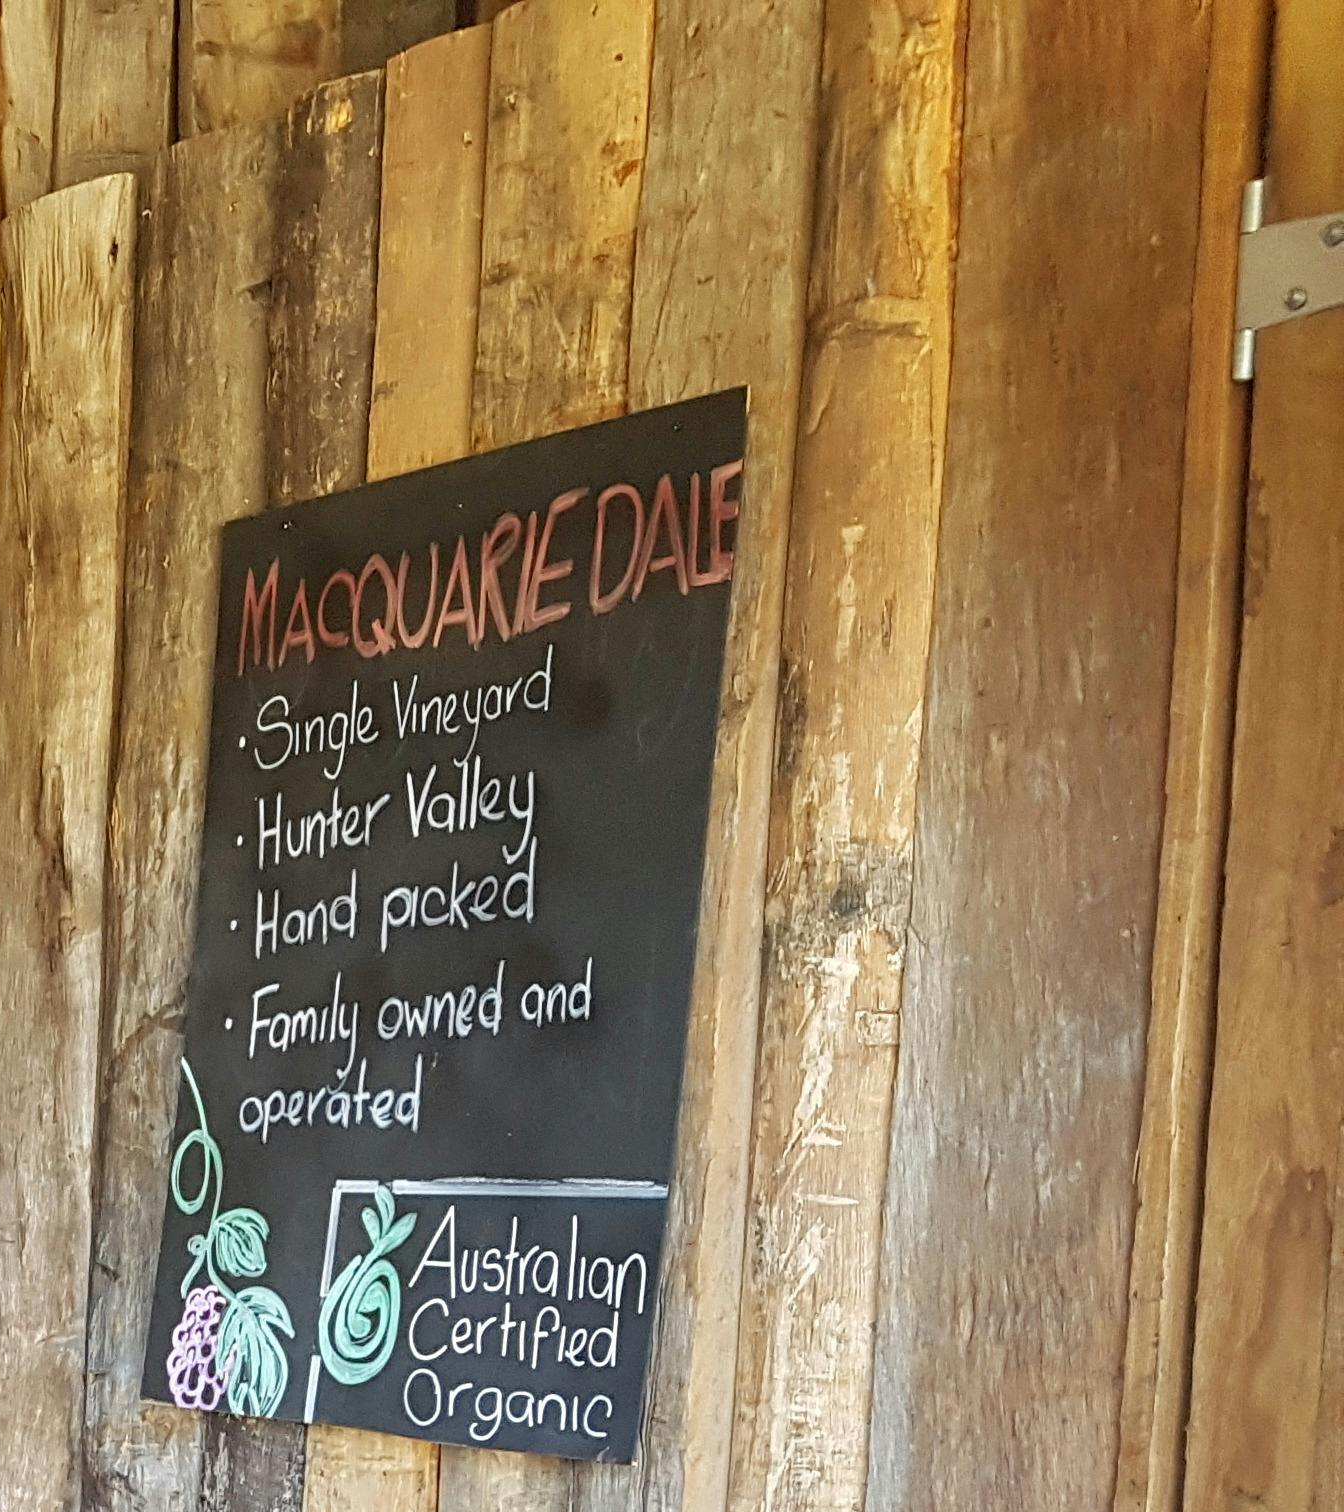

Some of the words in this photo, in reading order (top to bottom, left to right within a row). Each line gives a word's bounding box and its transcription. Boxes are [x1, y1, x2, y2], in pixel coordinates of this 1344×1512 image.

[255, 679, 378, 780] Single
[393, 644, 552, 767] Vineyard
[257, 794, 391, 869] Hunter
[406, 754, 536, 864] Valley
[254, 868, 358, 959] Hand
[381, 837, 537, 952] picked
[248, 970, 359, 1078] Family
[376, 960, 506, 1040] owned
[520, 957, 593, 1025] and
[238, 1056, 423, 1144] operated
[407, 1204, 648, 1314] Australian
[408, 1298, 620, 1370] Certified
[403, 1368, 613, 1441] Organic
